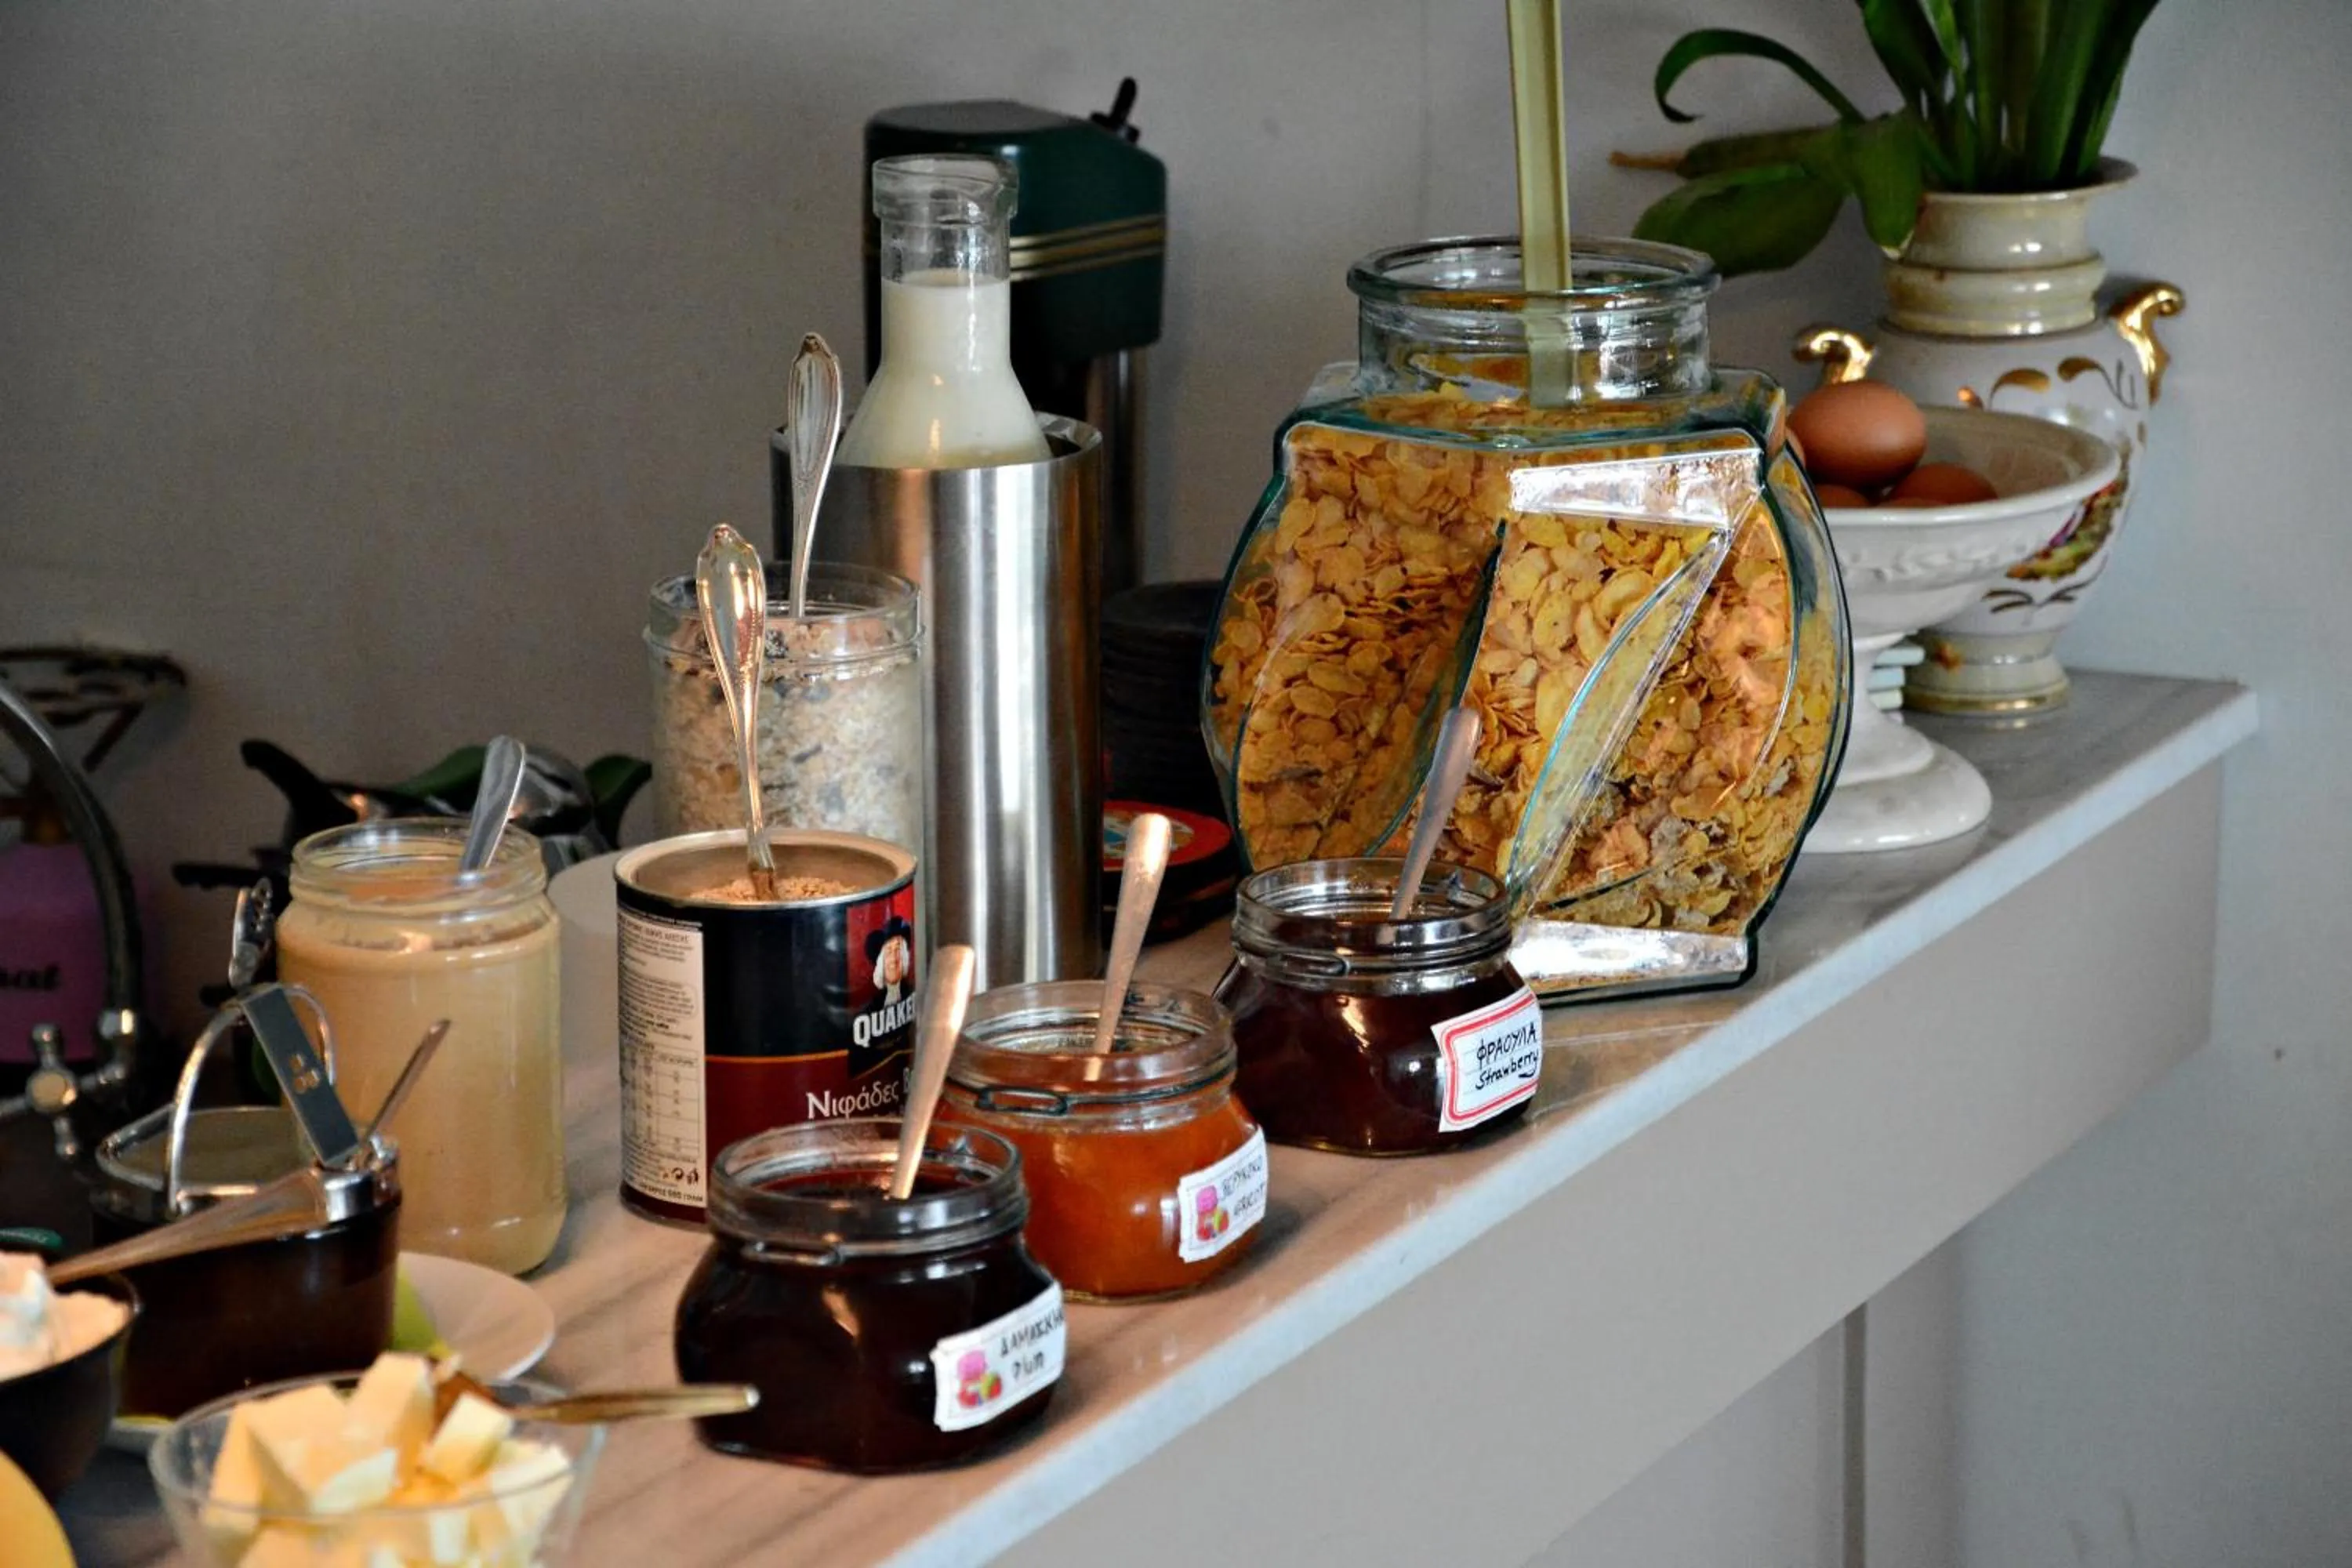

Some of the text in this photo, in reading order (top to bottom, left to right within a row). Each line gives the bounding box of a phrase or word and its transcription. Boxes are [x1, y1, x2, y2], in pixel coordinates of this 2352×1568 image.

[853, 993, 916, 1047] QUAKE
[1476, 1022, 1537, 1070] ΦΡΑΟΥΛΑ
[1475, 1048, 1539, 1091] Strawberry
[806, 1080, 899, 1120] Νιφάδες
